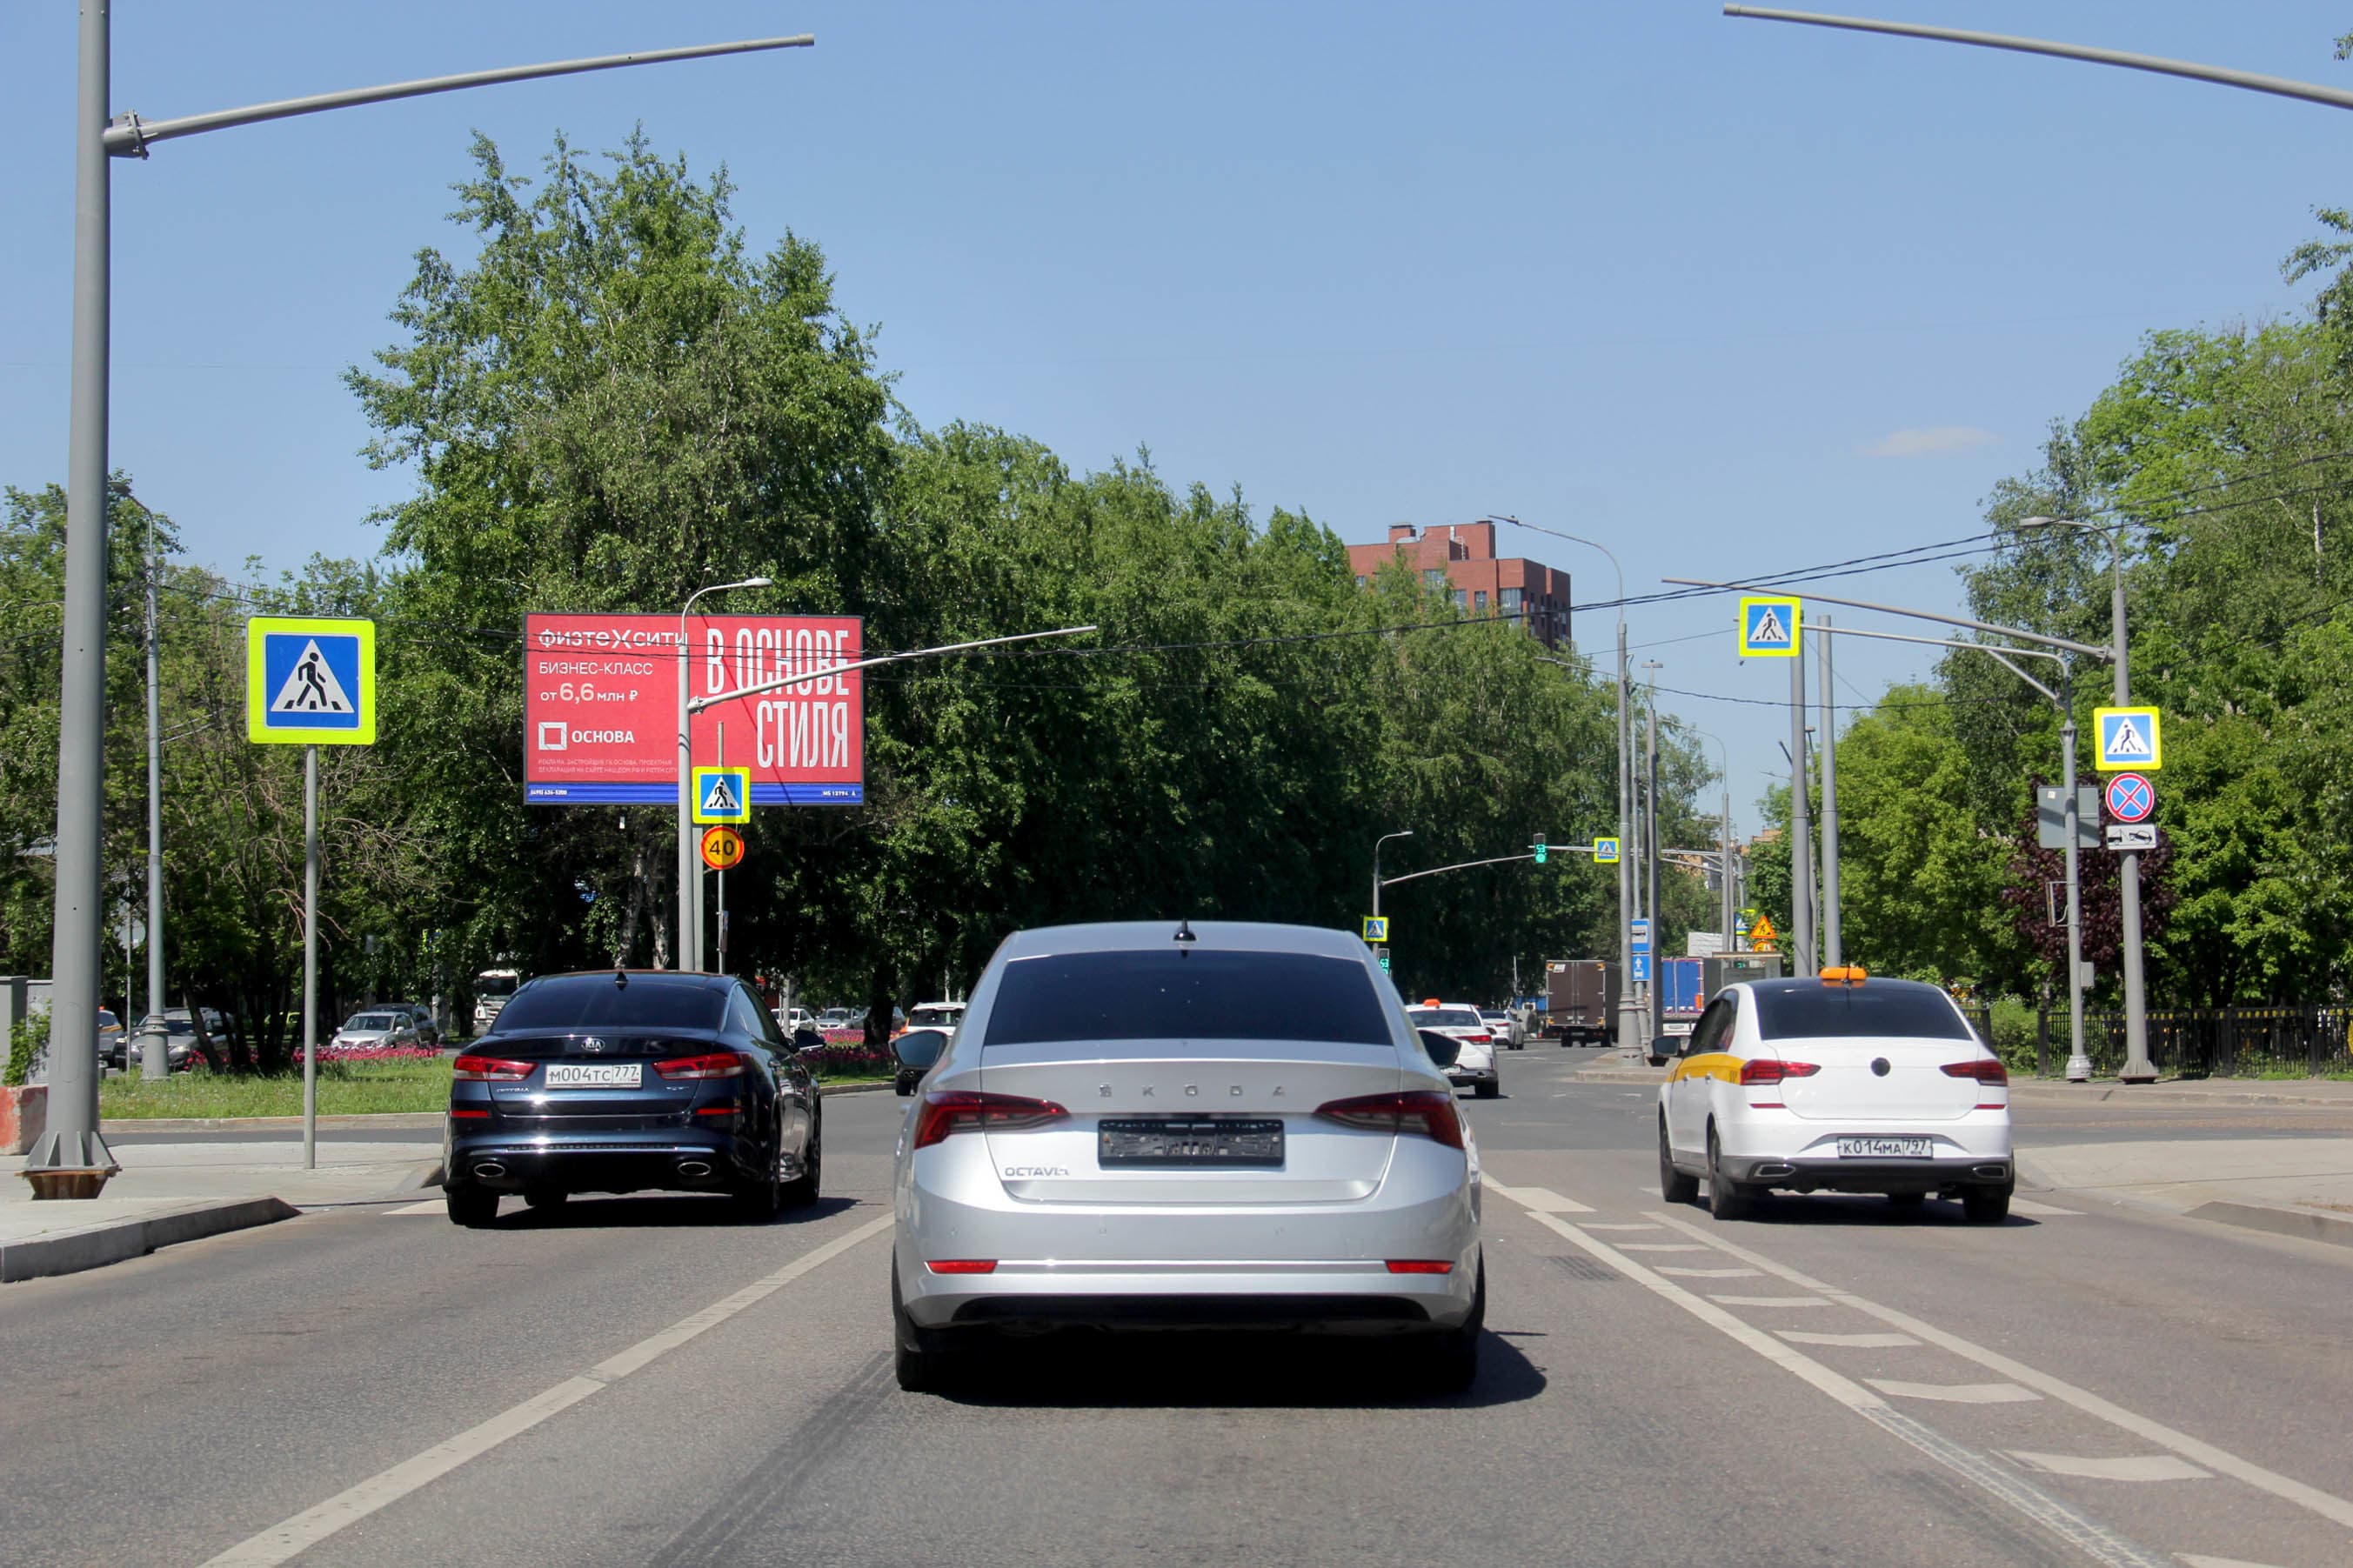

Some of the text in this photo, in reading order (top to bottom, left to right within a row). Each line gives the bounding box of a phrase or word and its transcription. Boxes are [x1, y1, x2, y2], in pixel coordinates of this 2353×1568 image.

[538, 662, 653, 676] БИЗНЕС-КЛАСС
[706, 628, 849, 696] В ОСНОВЕ
[559, 682, 595, 704] 6,6
[597, 692, 625, 701] млн
[572, 731, 635, 744] ОСНОВА
[756, 700, 848, 768] СТИЛЯ
[709, 839, 735, 857] 40
[585, 1040, 602, 1050] KIA
[1903, 1139, 1926, 1151] 797
